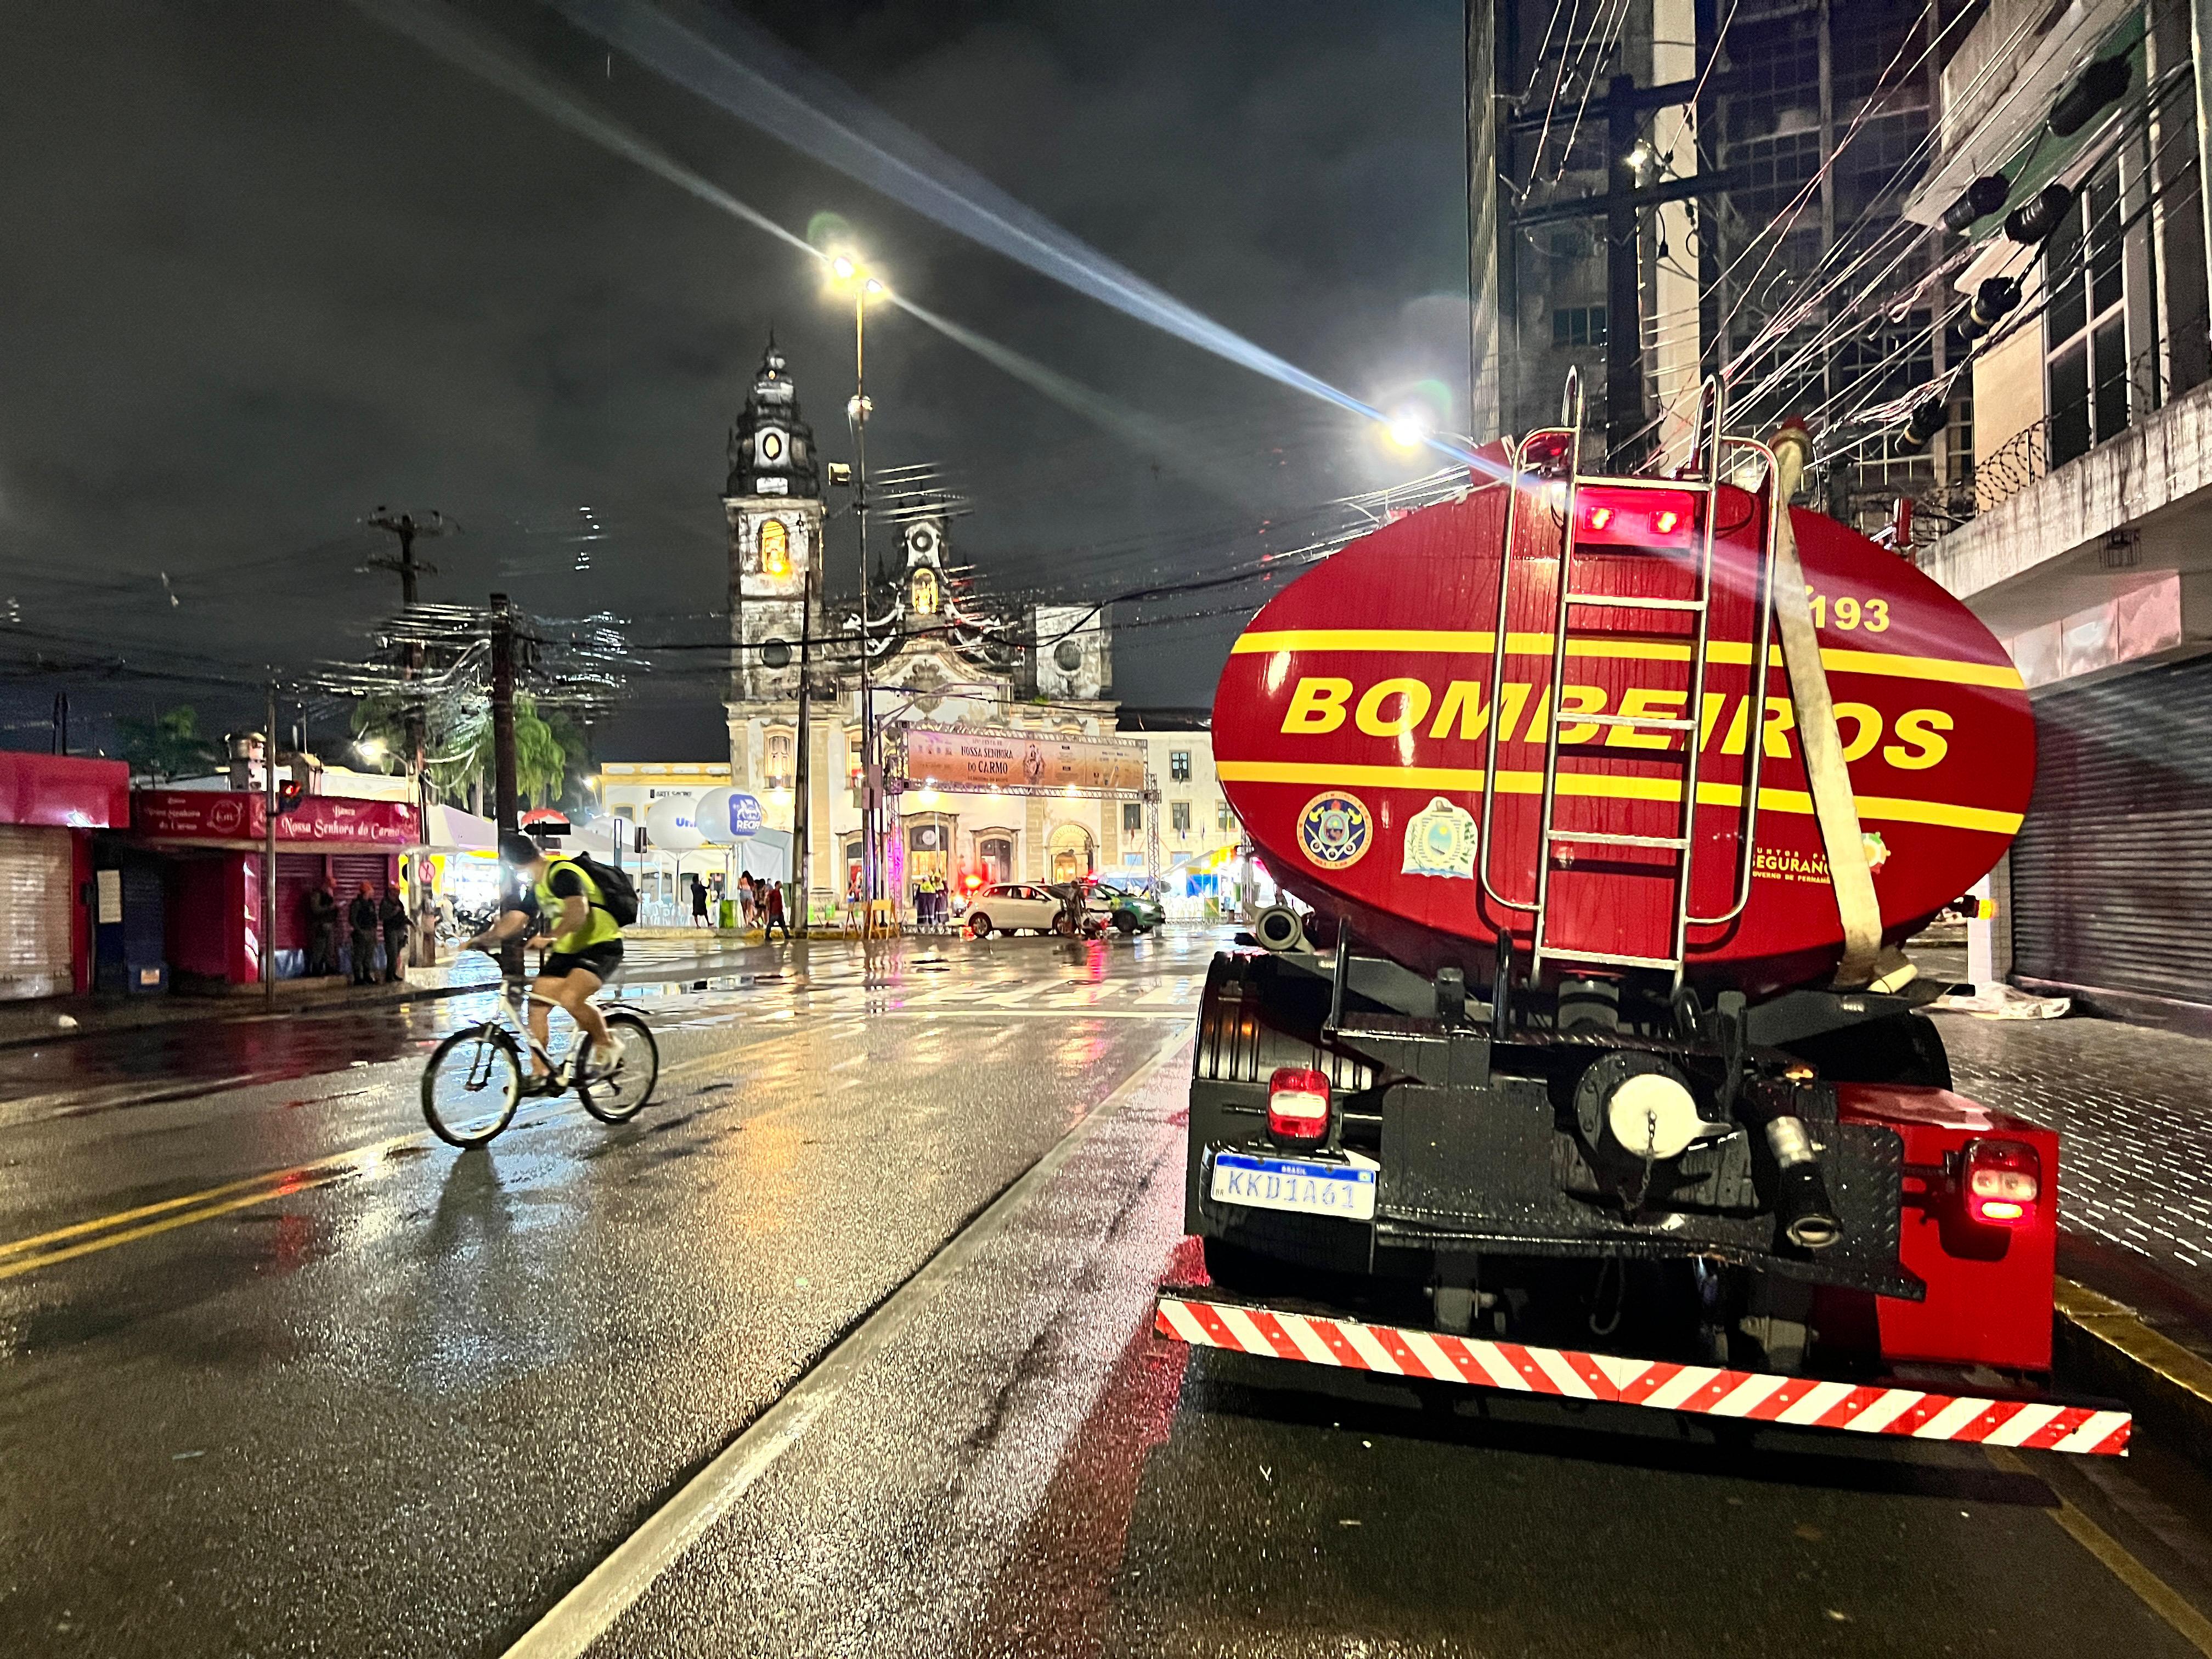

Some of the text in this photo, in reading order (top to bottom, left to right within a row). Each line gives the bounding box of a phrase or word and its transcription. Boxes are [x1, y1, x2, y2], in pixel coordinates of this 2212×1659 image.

[1809, 595, 1889, 632] 193
[1280, 678, 1955, 769] BOMBEIROS
[961, 746, 982, 757] NOSSA
[984, 748, 1013, 759] SENHORA
[968, 761, 1008, 774] DO CARMO
[281, 817, 311, 837] Nossa
[314, 819, 354, 838] Senhora
[358, 821, 368, 836] do
[371, 823, 399, 839] Carmo
[1757, 847, 1799, 857] UNTOS
[1753, 871, 1781, 879] OVERNO
[1215, 1188, 1224, 1197] BR
[1228, 1170, 1353, 1207] KKD1A61
